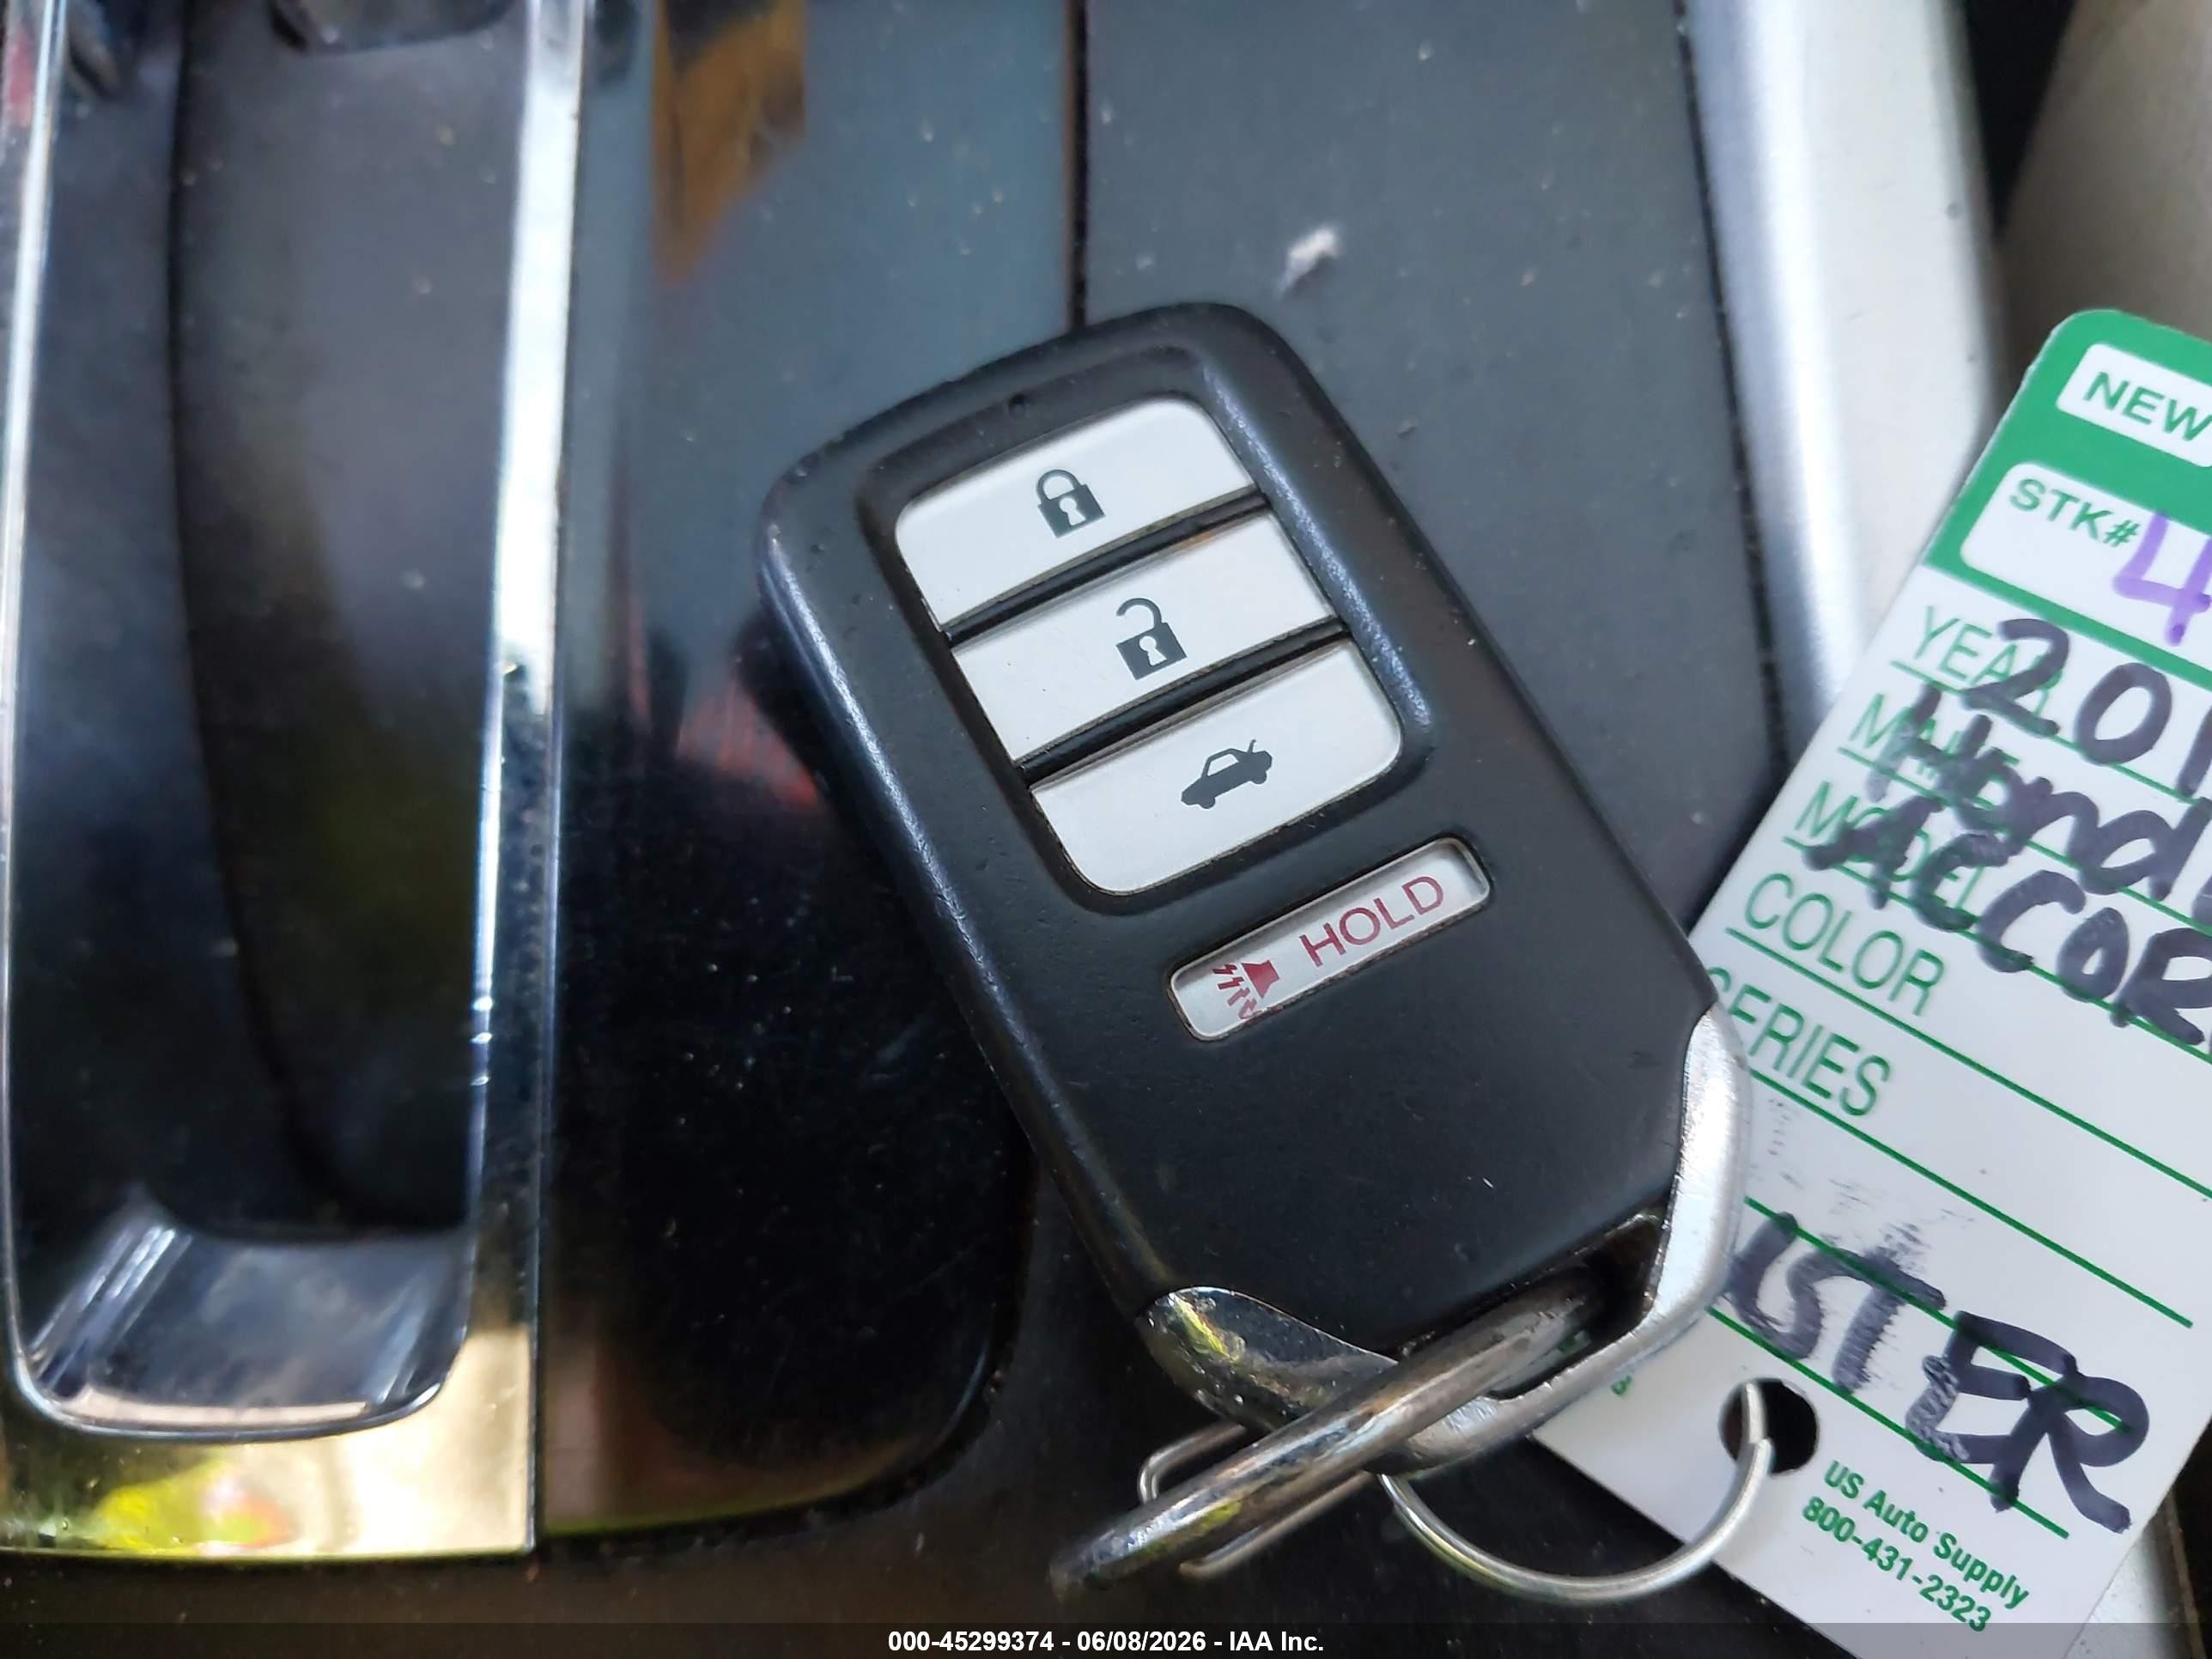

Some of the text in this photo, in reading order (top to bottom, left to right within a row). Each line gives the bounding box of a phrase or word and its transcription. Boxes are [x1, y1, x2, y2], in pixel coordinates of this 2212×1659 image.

[2083, 371, 2212, 442] NEW
[2008, 478, 2141, 549] STK#
[2112, 513, 2212, 647] 4
[1299, 875, 1444, 968] HOLD
[1744, 872, 1945, 1017] COLOR
[1802, 1496, 1992, 1632] 800-431-2323
[1824, 1460, 2030, 1609] US Auto Supply
